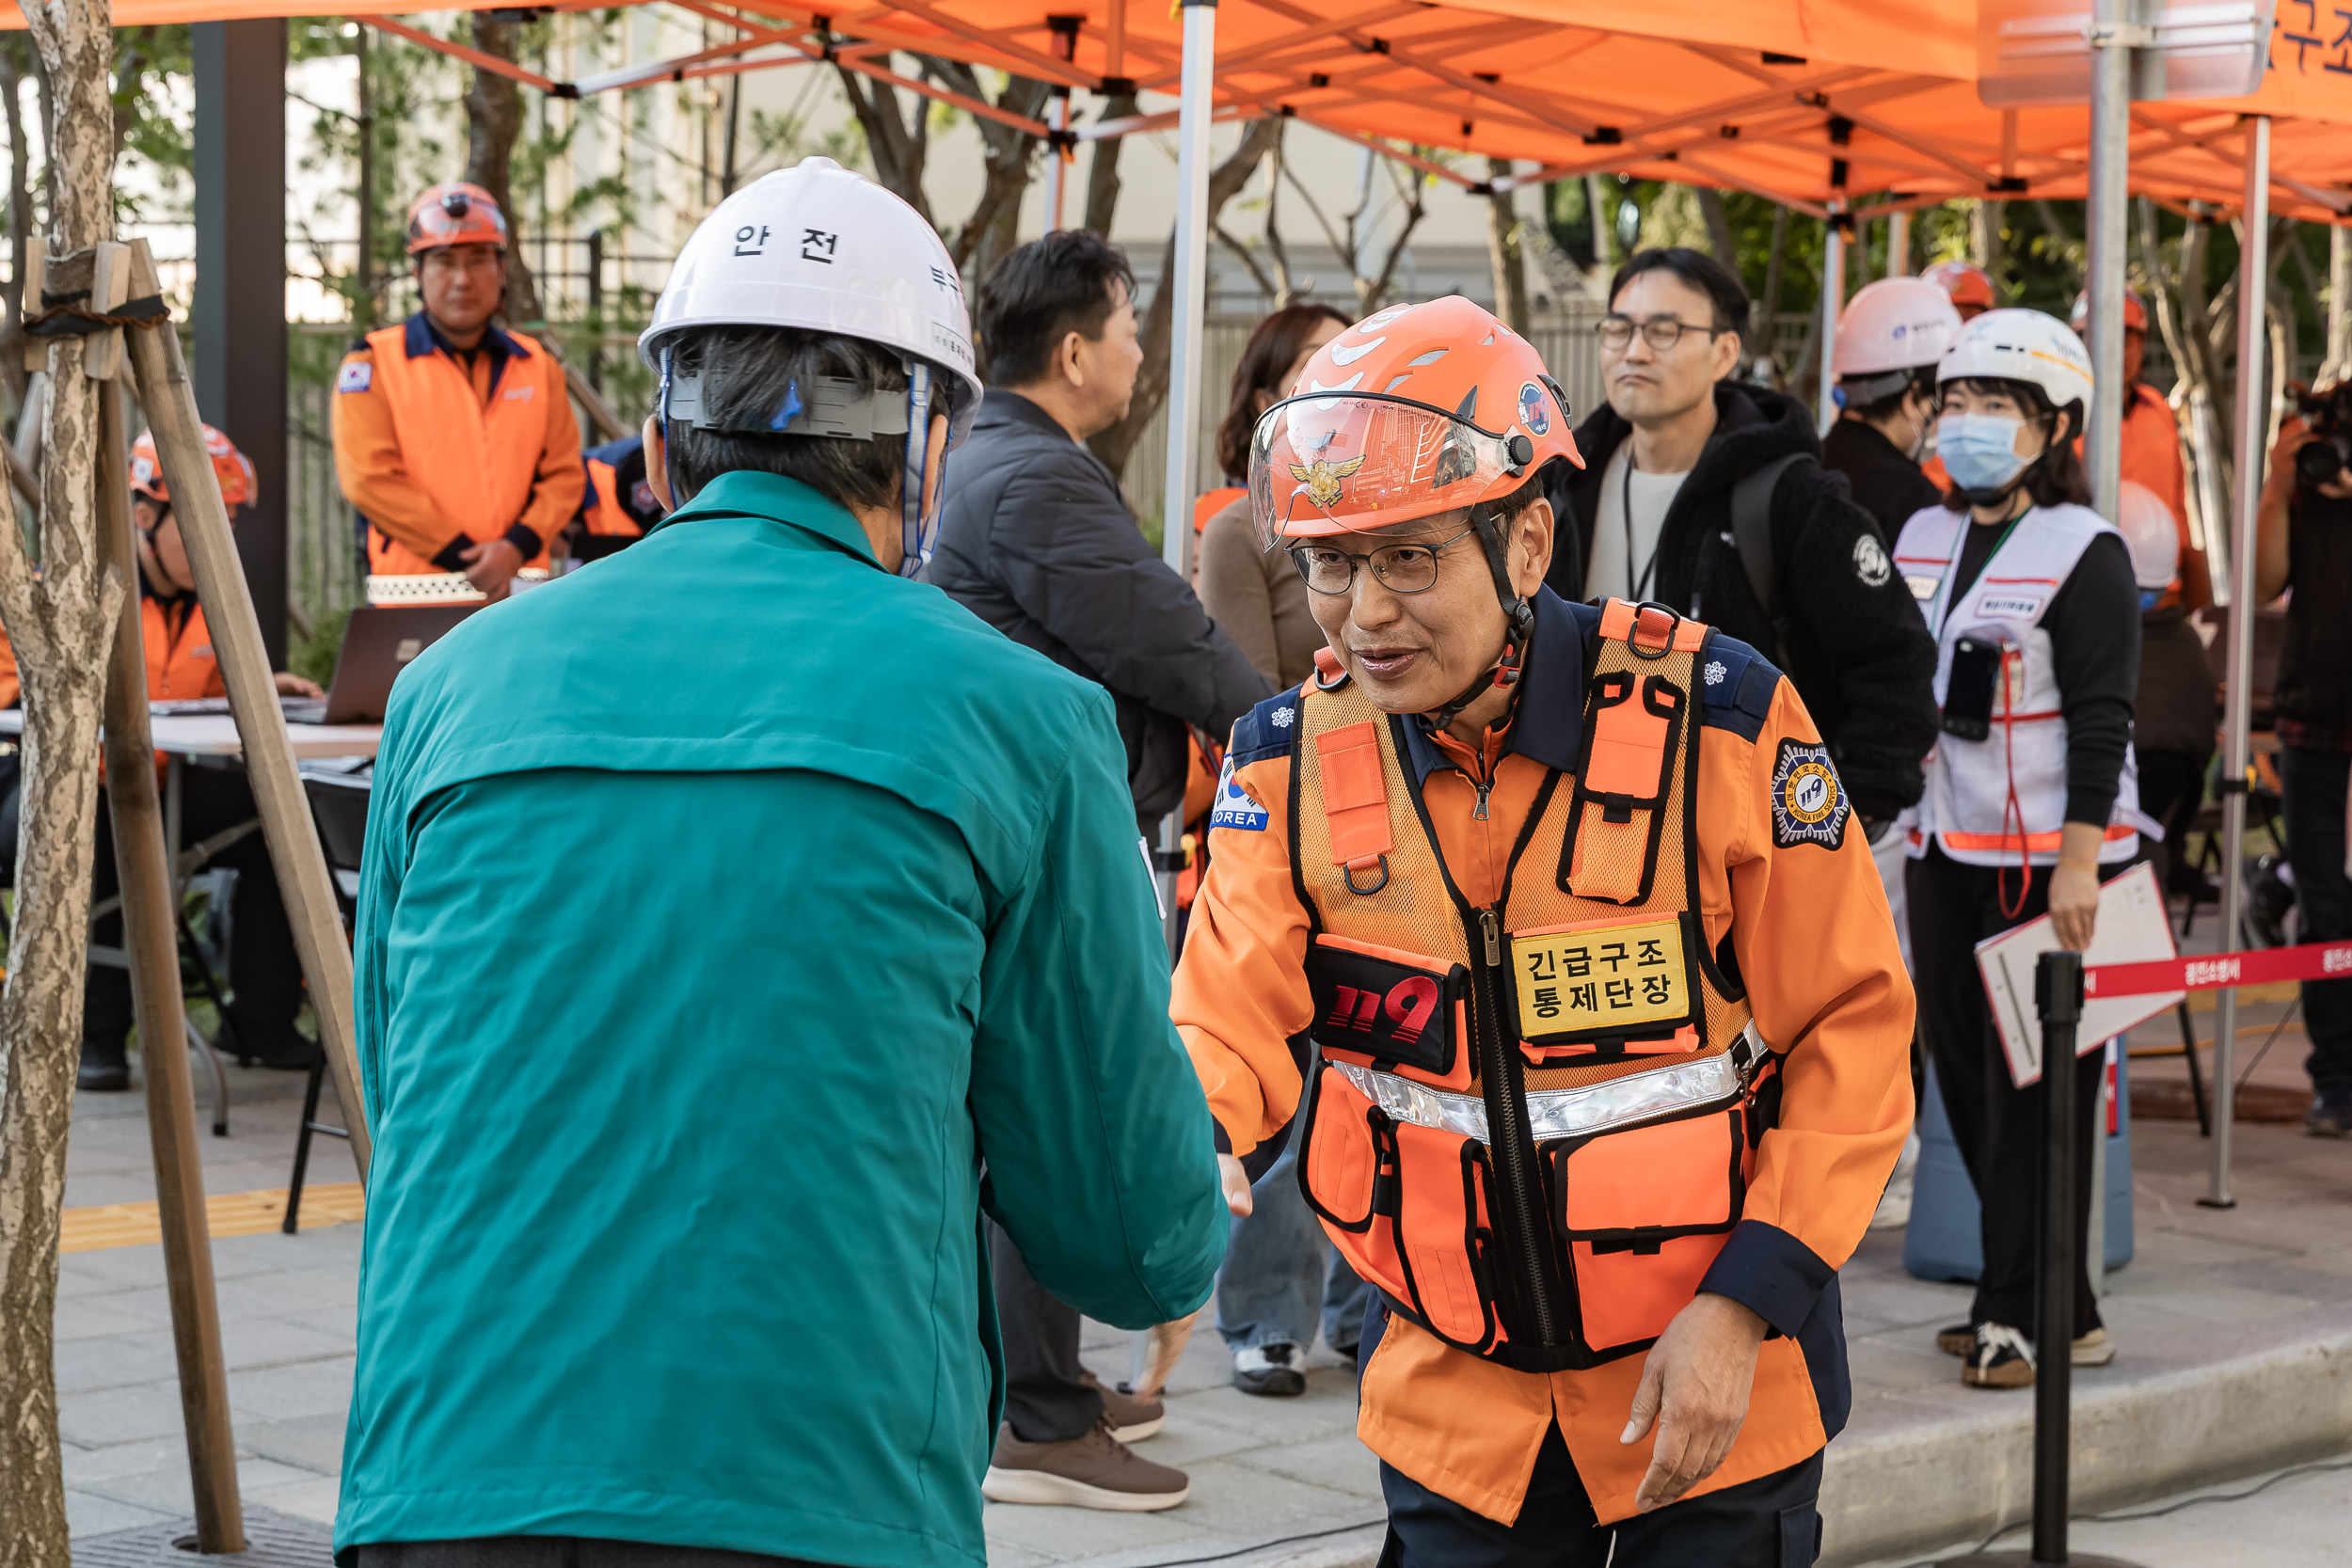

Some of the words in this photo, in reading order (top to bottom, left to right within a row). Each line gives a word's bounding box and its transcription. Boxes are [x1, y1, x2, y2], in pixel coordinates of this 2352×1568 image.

[2268, 0, 2352, 75] 구조
[1528, 392, 1549, 422] 119
[1792, 808, 1811, 821] KOREA
[1812, 811, 1826, 821] FIRE
[1824, 784, 1836, 811] SERVICE
[1800, 778, 1822, 807] 119
[1527, 939, 1667, 982] 긴급구조
[1327, 975, 1438, 1045] 119
[1532, 974, 1672, 1019] 통제단장
